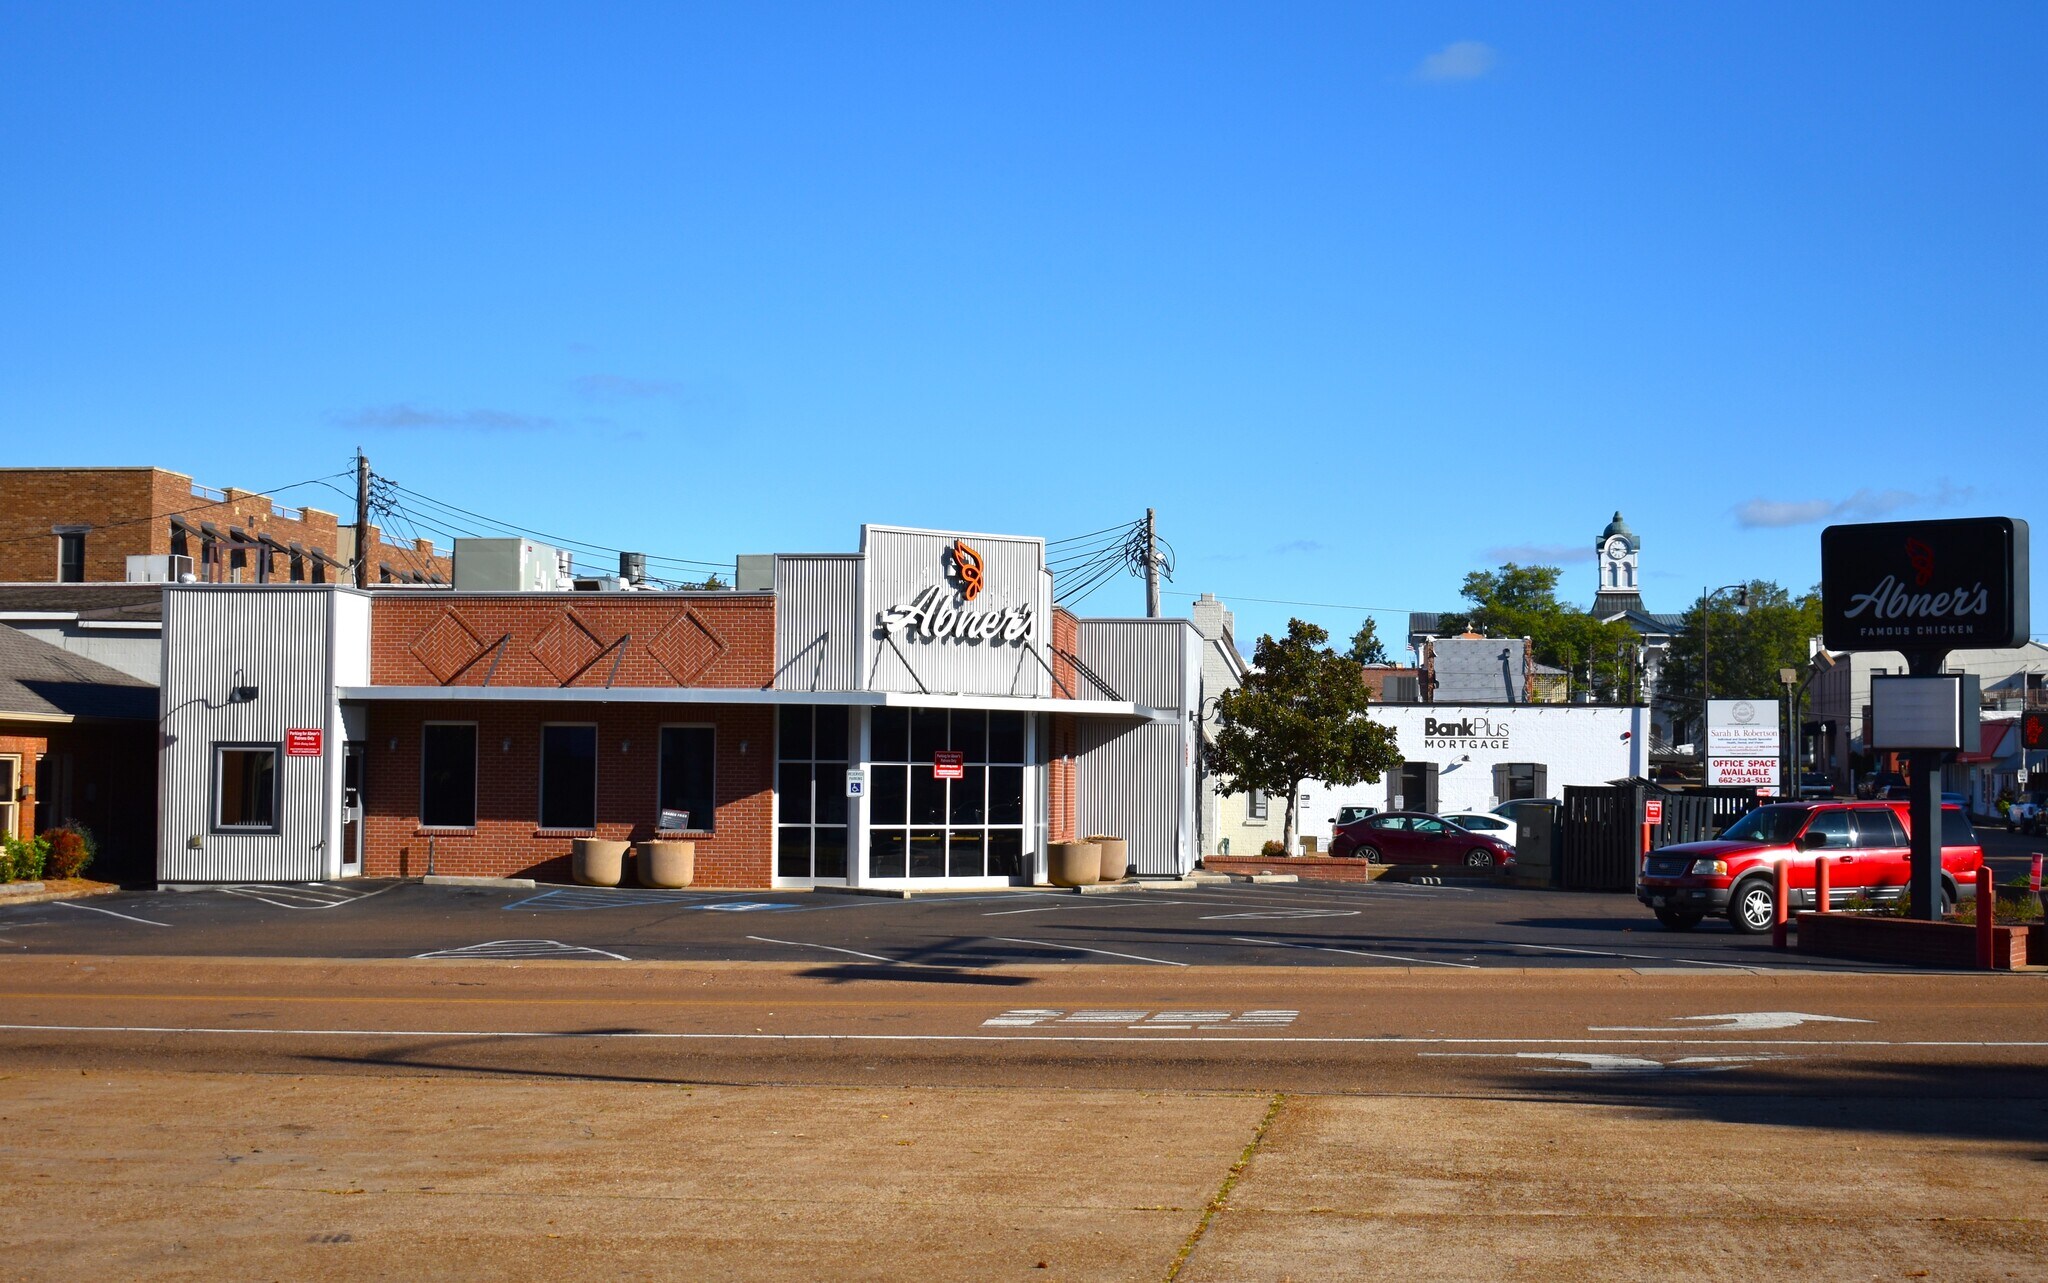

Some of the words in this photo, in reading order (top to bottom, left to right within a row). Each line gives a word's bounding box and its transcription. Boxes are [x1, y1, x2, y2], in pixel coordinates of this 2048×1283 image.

[1844, 575, 1988, 619] Abner's
[886, 585, 1037, 641] Abner's
[1860, 627, 1910, 636] FAMOUS
[1917, 625, 1974, 635] CHICKEN
[1425, 718, 1510, 737] BankPlus
[1711, 729, 1732, 737] Sarah
[1743, 729, 1778, 737] Robertson
[1425, 740, 1510, 749] MORTGAGE
